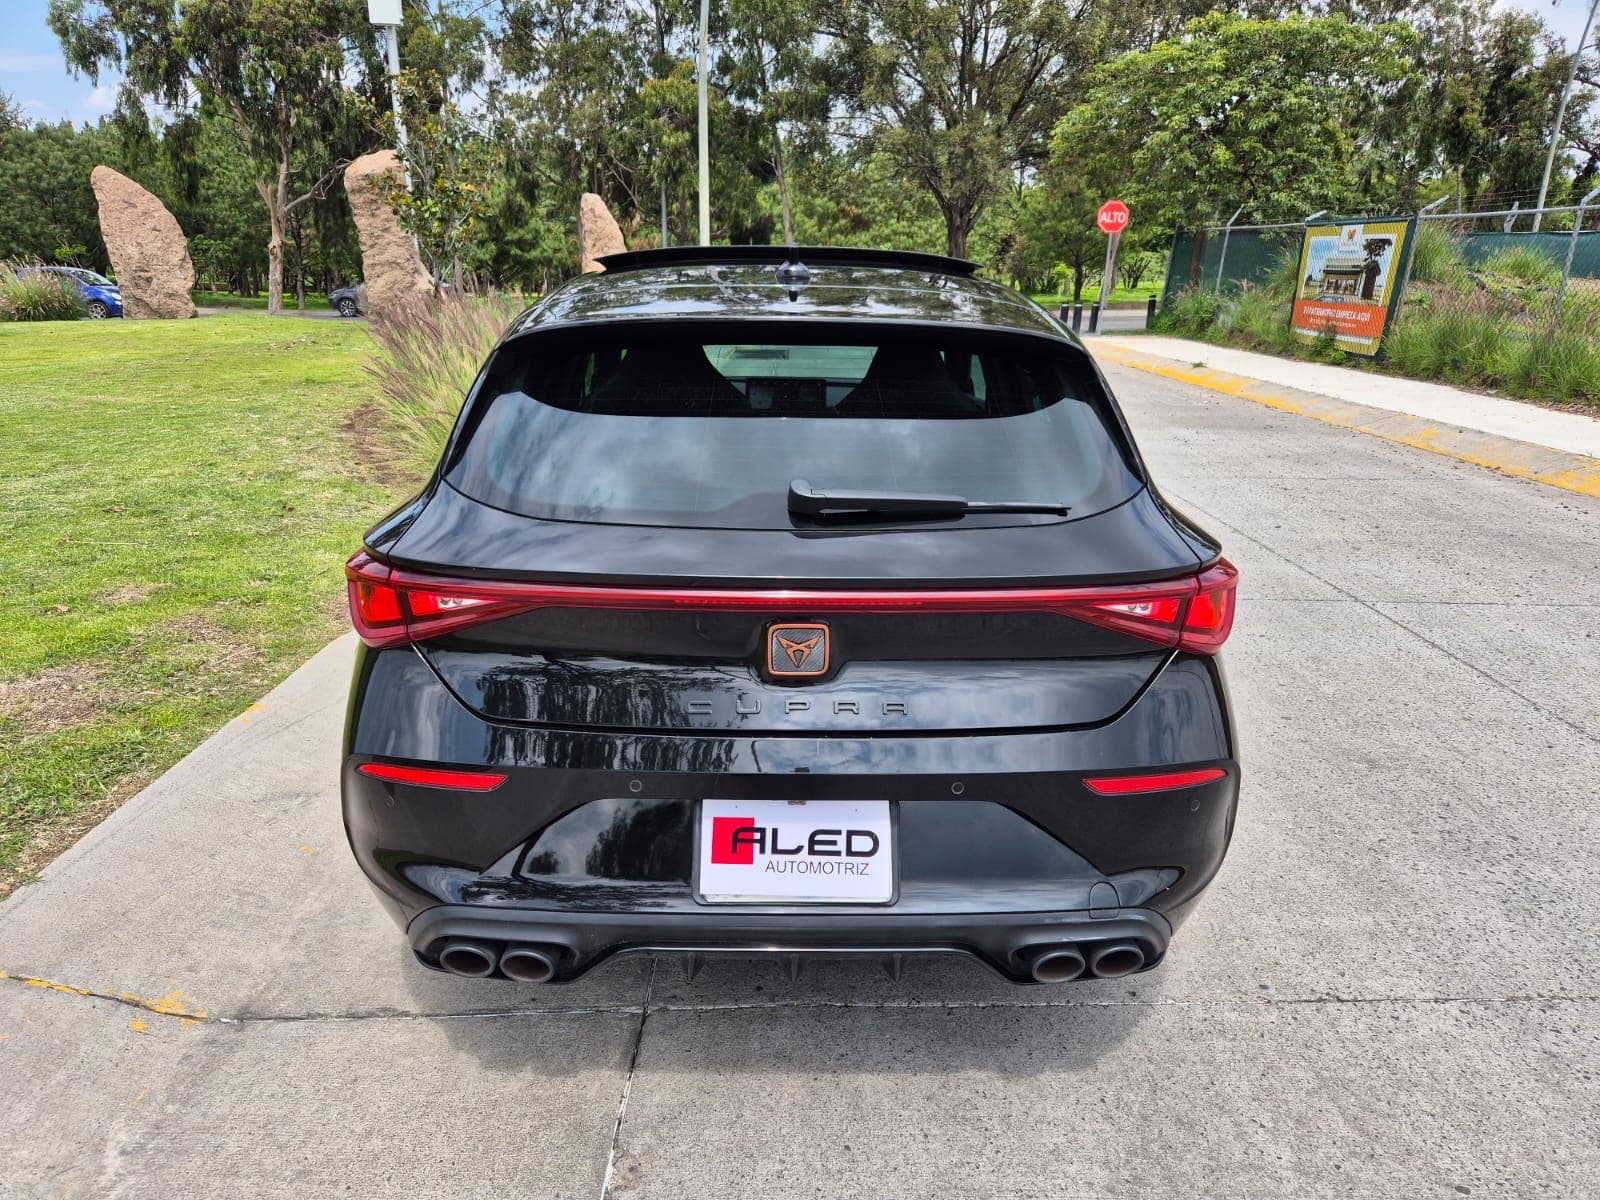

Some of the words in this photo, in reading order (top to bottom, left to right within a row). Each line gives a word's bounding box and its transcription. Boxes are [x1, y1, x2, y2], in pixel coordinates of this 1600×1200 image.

[1100, 211, 1126, 223] ALTO
[687, 699, 909, 716] CUPRA
[731, 826, 880, 858] ALED
[765, 860, 870, 876] AUTOMOTRIZ
